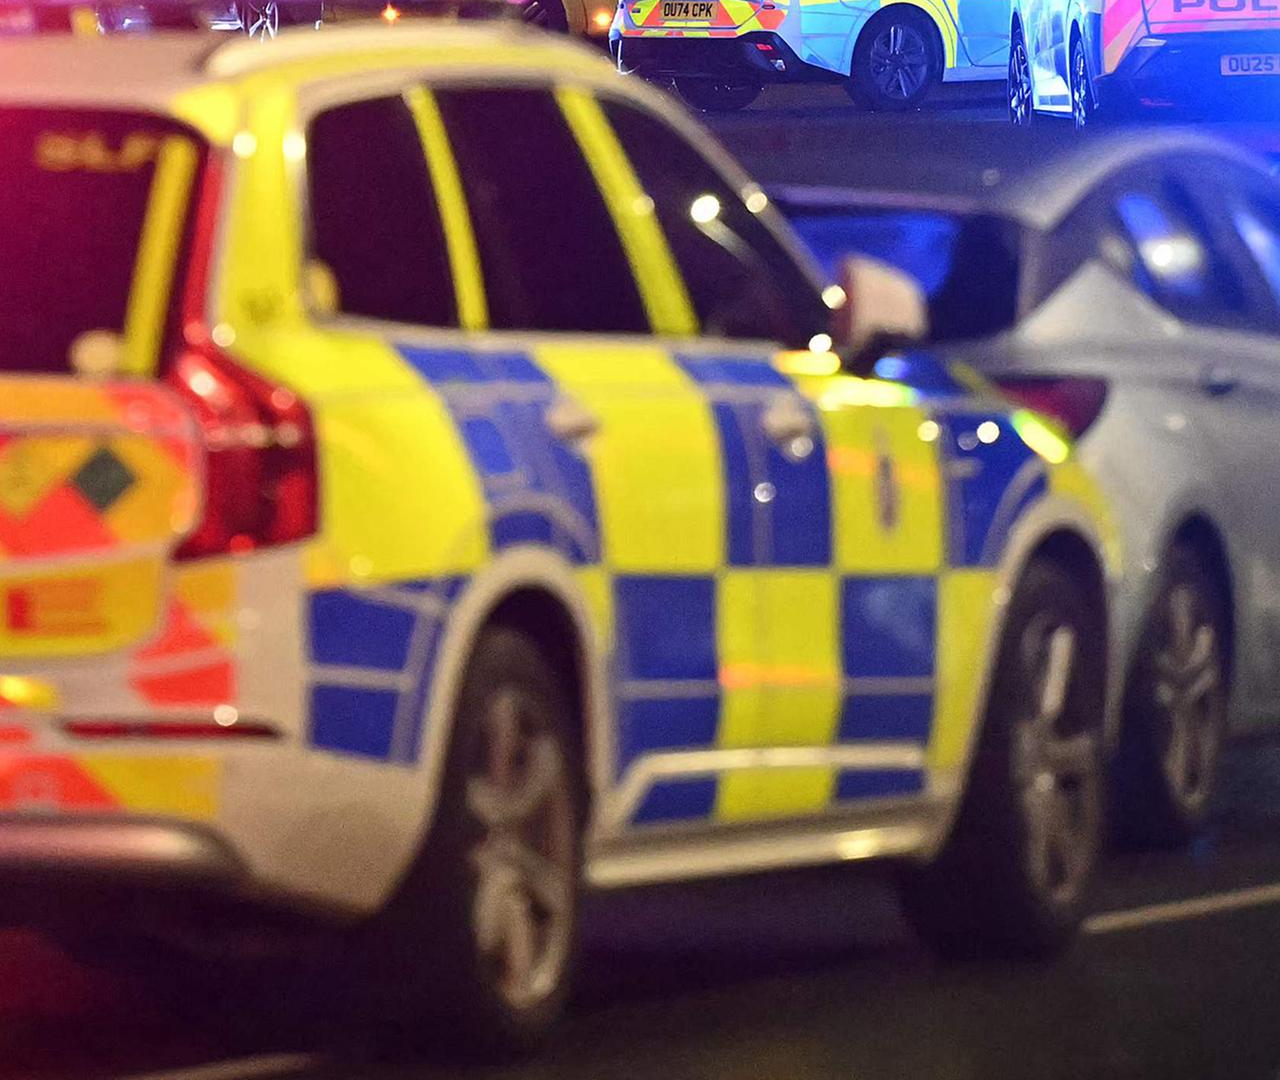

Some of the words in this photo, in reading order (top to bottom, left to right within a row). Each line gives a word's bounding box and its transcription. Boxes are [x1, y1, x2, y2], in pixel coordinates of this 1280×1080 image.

[663, 2, 690, 18] OU74
[691, 2, 714, 18] CPK
[1228, 56, 1274, 72] OU25
